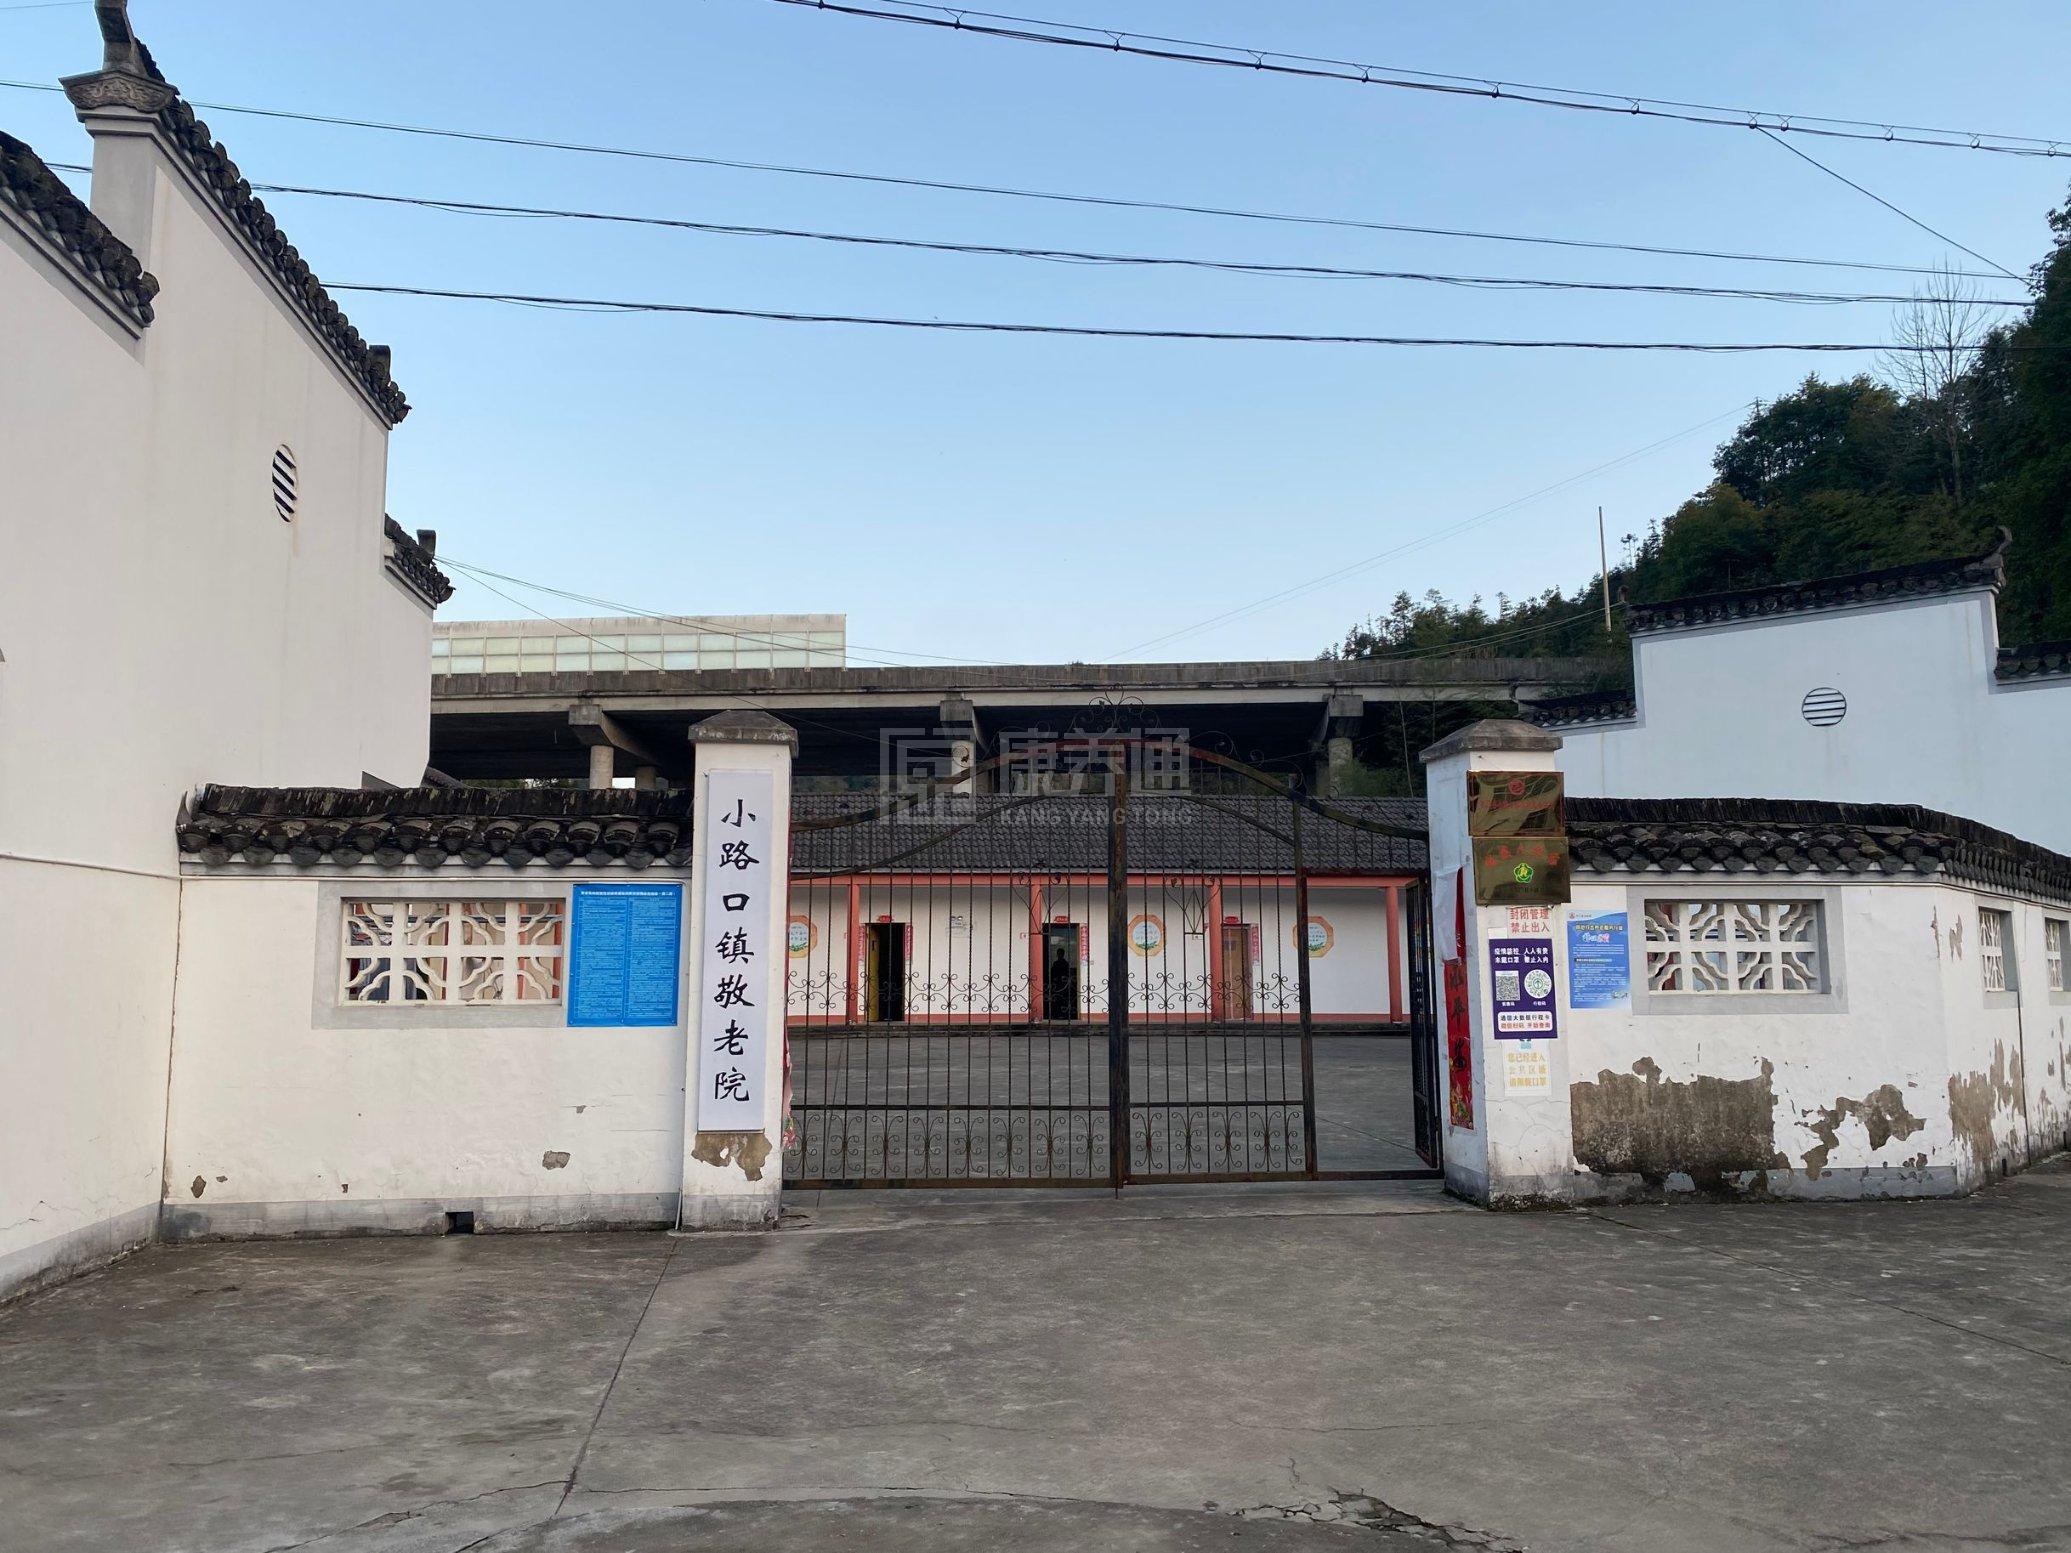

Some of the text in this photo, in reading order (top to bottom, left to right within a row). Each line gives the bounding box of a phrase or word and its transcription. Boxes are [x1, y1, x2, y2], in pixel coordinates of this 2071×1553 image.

[1510, 908, 1549, 920] 封闭管理
[1511, 922, 1549, 933] 禁止出入
[713, 798, 760, 1102] 小路口镇敬老院
[1524, 947, 1548, 955] 人人有责
